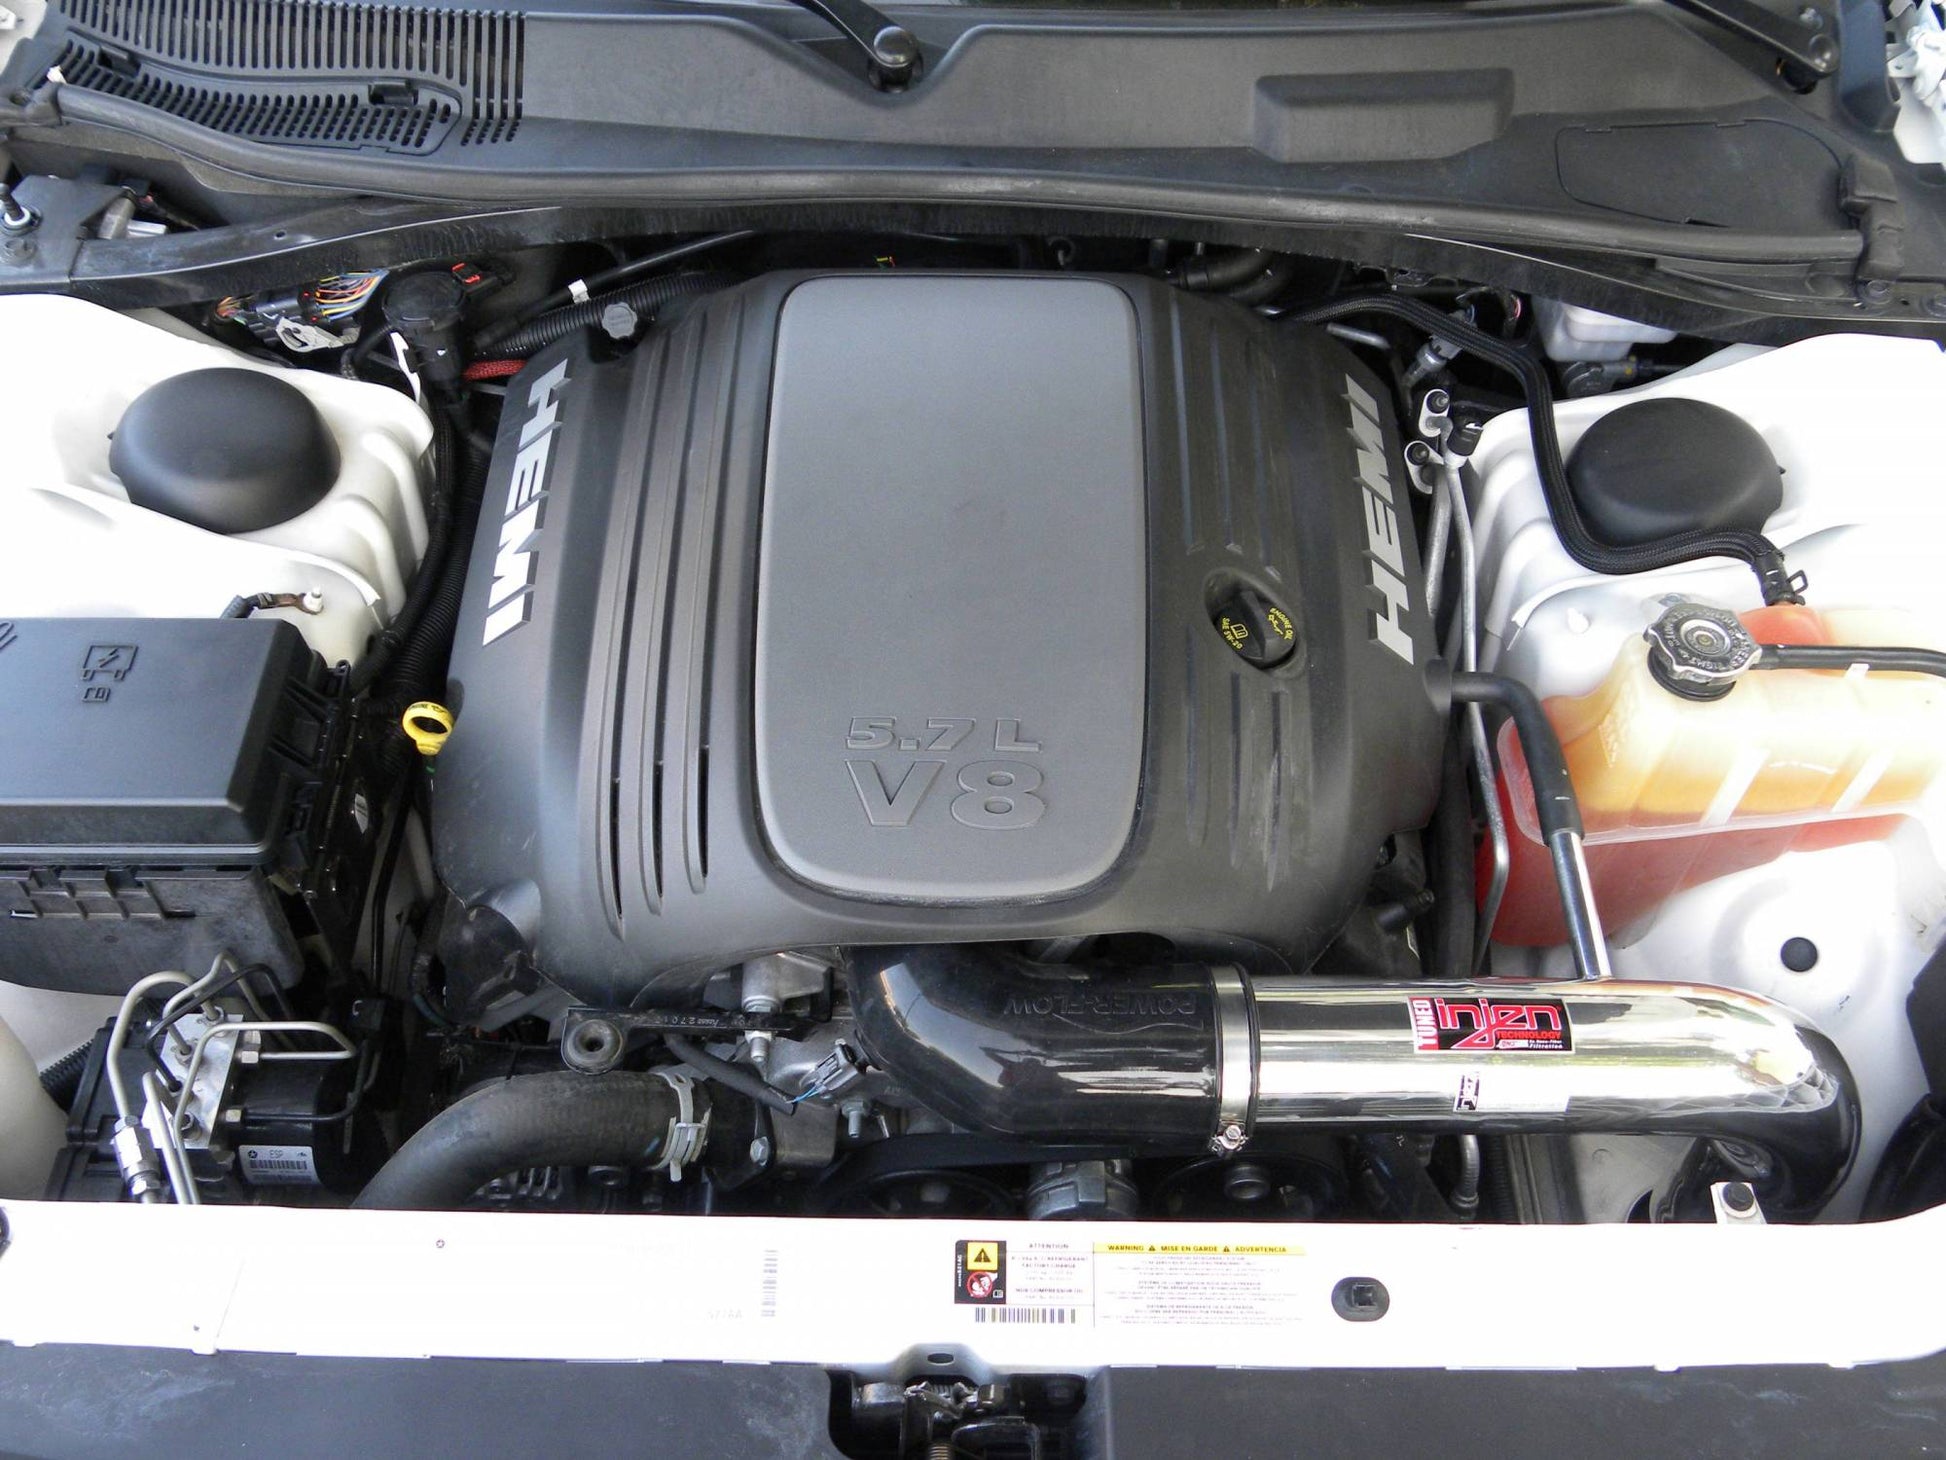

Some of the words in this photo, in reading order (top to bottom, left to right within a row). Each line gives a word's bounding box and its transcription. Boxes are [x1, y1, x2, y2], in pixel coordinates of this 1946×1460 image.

[481, 357, 570, 647] HEMI
[1342, 372, 1414, 666] HEMI
[1222, 617, 1231, 629] SAE
[1269, 607, 1292, 629] ENGINE
[844, 758, 1048, 831] V8
[1002, 994, 1197, 1016] POWER-FLOW
[1412, 999, 1438, 1048] TUNED
[1434, 997, 1563, 1049] injen
[1495, 1030, 1562, 1039] TECHNOLOGY
